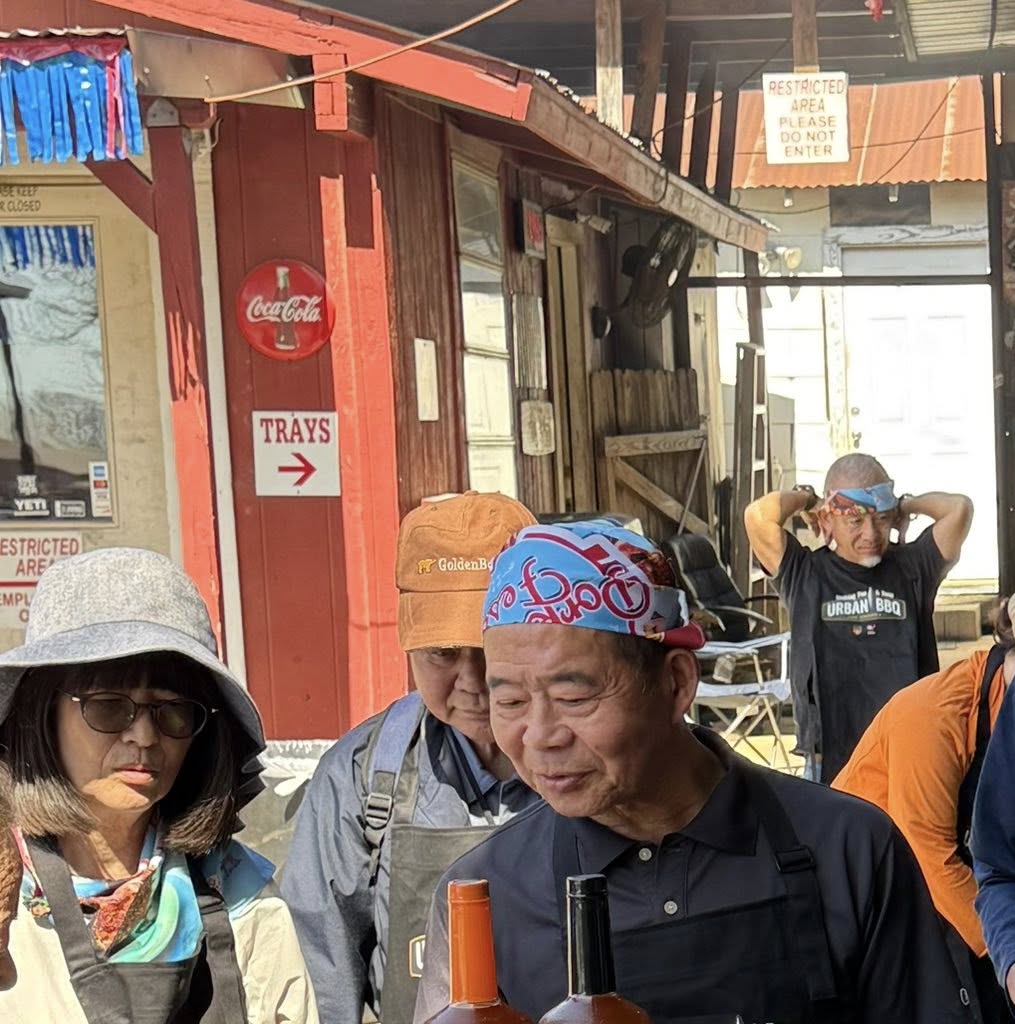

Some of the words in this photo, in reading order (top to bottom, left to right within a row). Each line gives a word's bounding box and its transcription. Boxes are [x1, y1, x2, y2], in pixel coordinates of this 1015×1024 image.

[769, 79, 844, 95] RESTRICTED
[791, 98, 825, 113] AREA
[780, 116, 837, 128] PLEASE
[781, 132, 801, 143] DO
[807, 131, 835, 142] NOT
[785, 145, 832, 158] ENTER
[7, 200, 41, 212] CLOSED
[246, 295, 322, 322] Coca-Cola
[260, 418, 331, 444] TRAYS
[14, 498, 47, 511] YETI
[0, 538, 79, 556] ESTRICTED
[827, 599, 868, 617] URBAN
[876, 598, 901, 616] BBQ
